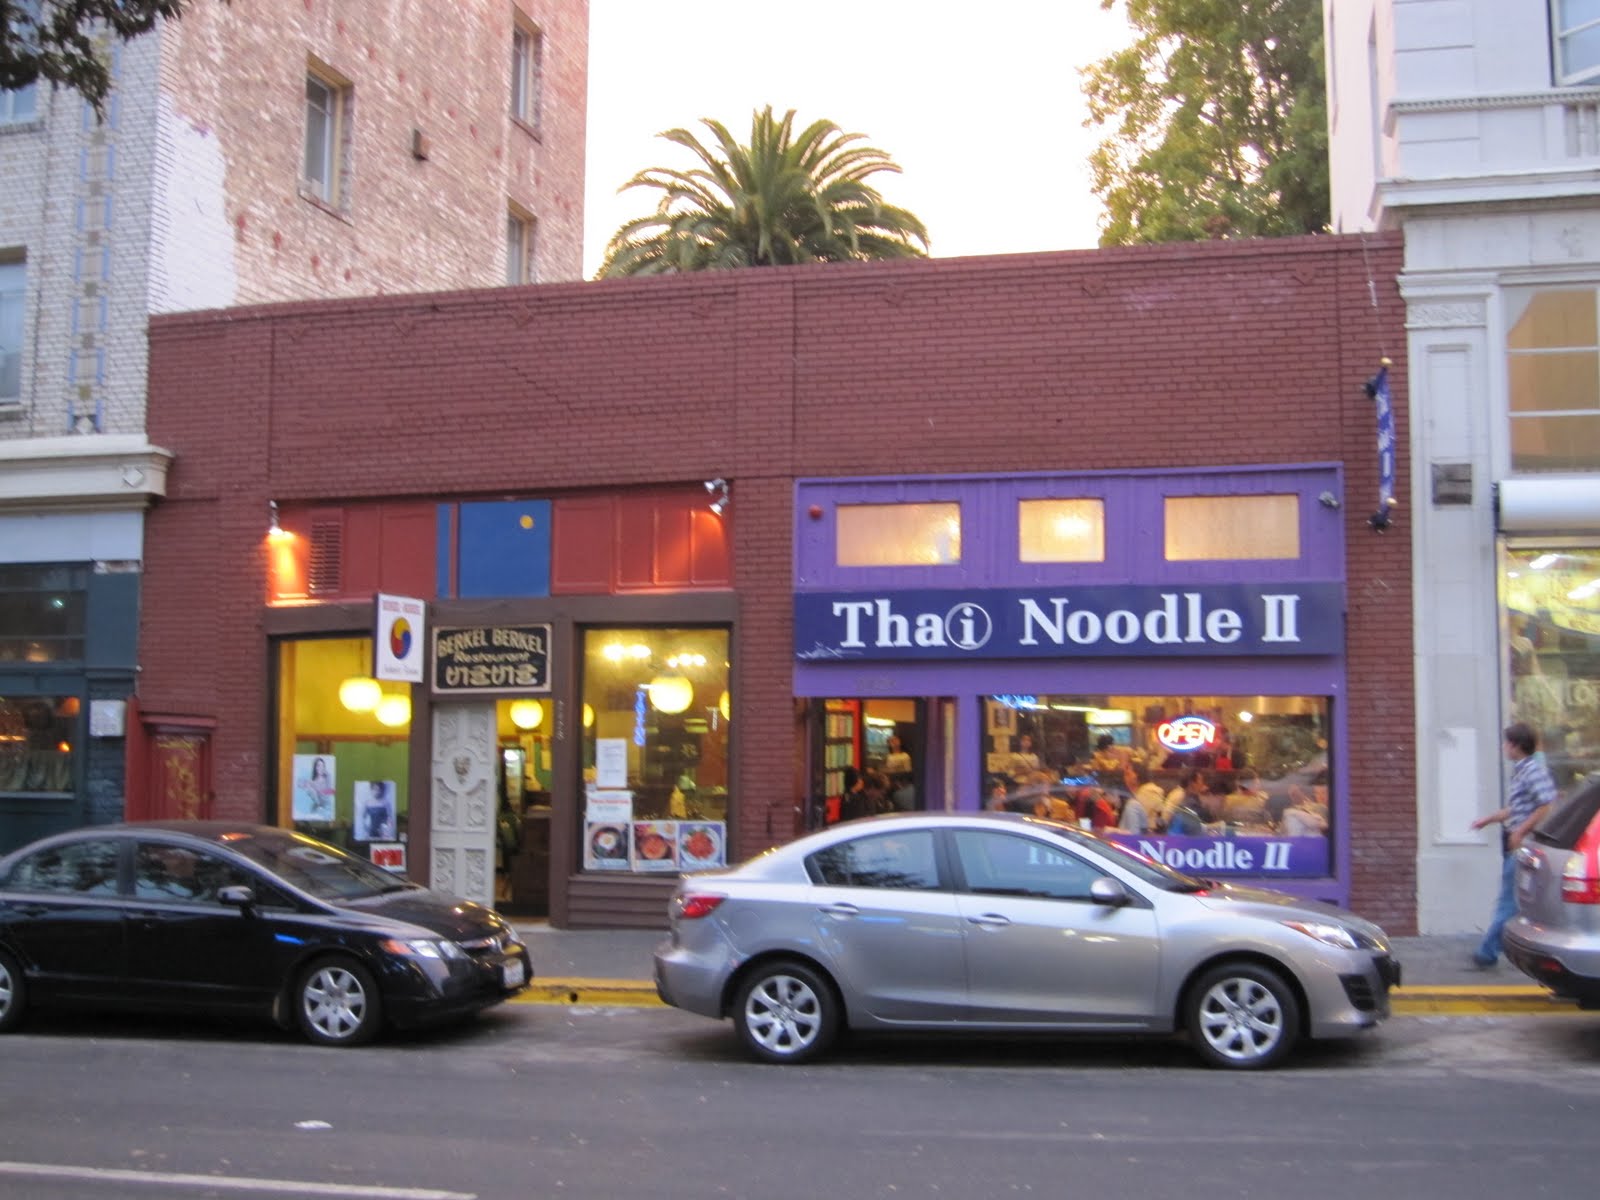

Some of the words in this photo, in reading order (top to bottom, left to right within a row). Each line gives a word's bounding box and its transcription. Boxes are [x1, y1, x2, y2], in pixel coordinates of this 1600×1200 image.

[832, 599, 992, 650] Thai
[1018, 593, 1243, 646] Noodle
[1260, 594, 1301, 644] II
[1158, 722, 1216, 744] OPEN
[1138, 839, 1254, 870] Noodle
